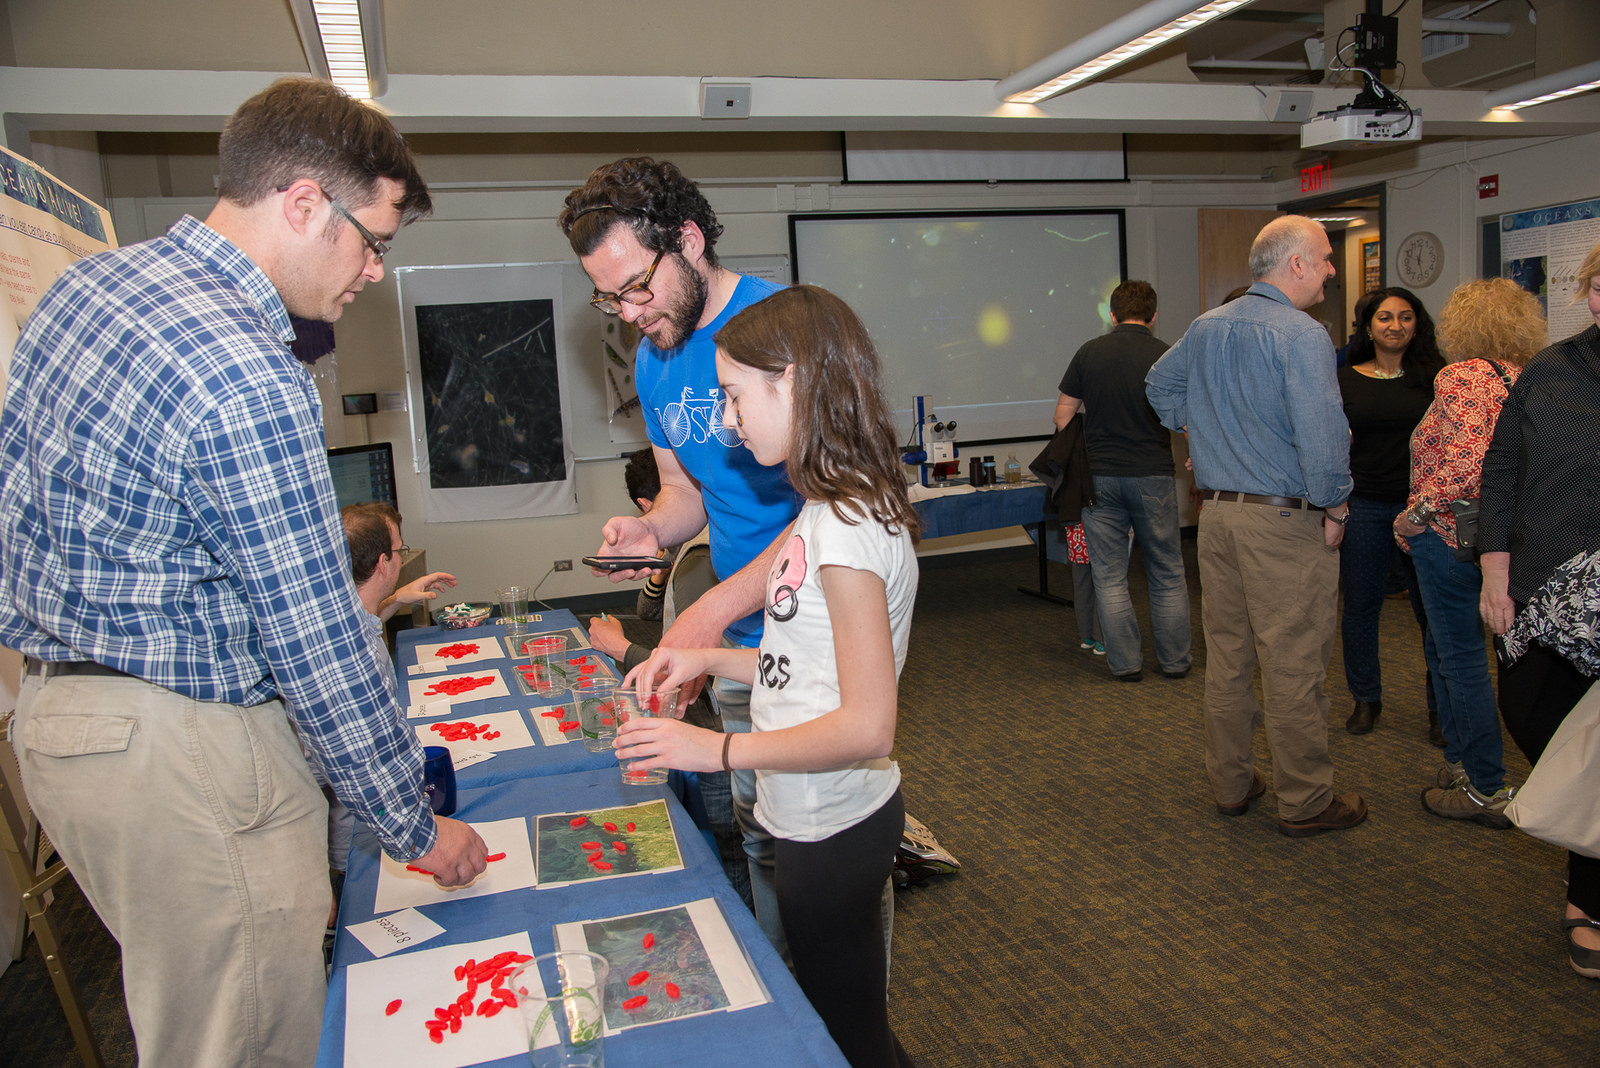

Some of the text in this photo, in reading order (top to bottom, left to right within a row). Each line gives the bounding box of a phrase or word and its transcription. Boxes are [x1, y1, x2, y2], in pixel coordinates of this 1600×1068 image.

[1301, 164, 1324, 193] EXIT
[0, 163, 84, 226] CEANS ALIVE!
[1533, 207, 1592, 224] OCEANS
[758, 648, 791, 690] es
[376, 918, 411, 944] 8 pieces
